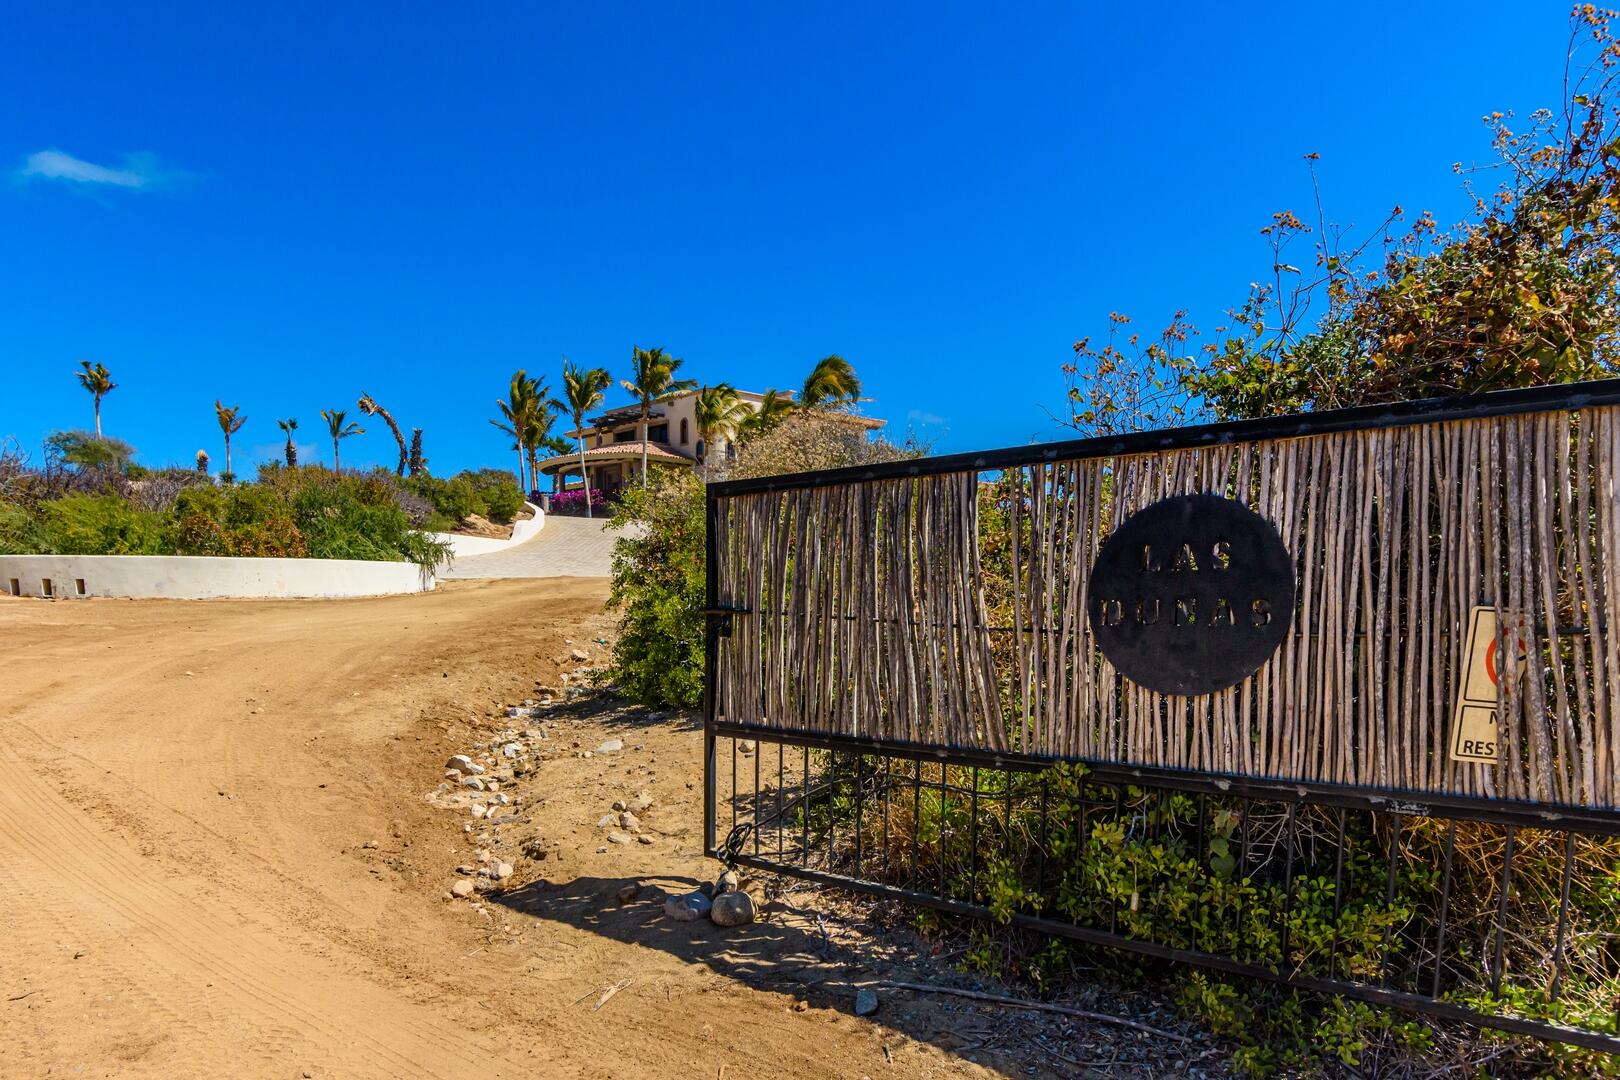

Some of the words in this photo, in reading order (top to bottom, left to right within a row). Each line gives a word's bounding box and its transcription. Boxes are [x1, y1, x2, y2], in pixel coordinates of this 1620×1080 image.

[1139, 541, 1232, 572] LAS
[1100, 598, 1272, 627] DUNAS
[1463, 740, 1498, 756] RES
